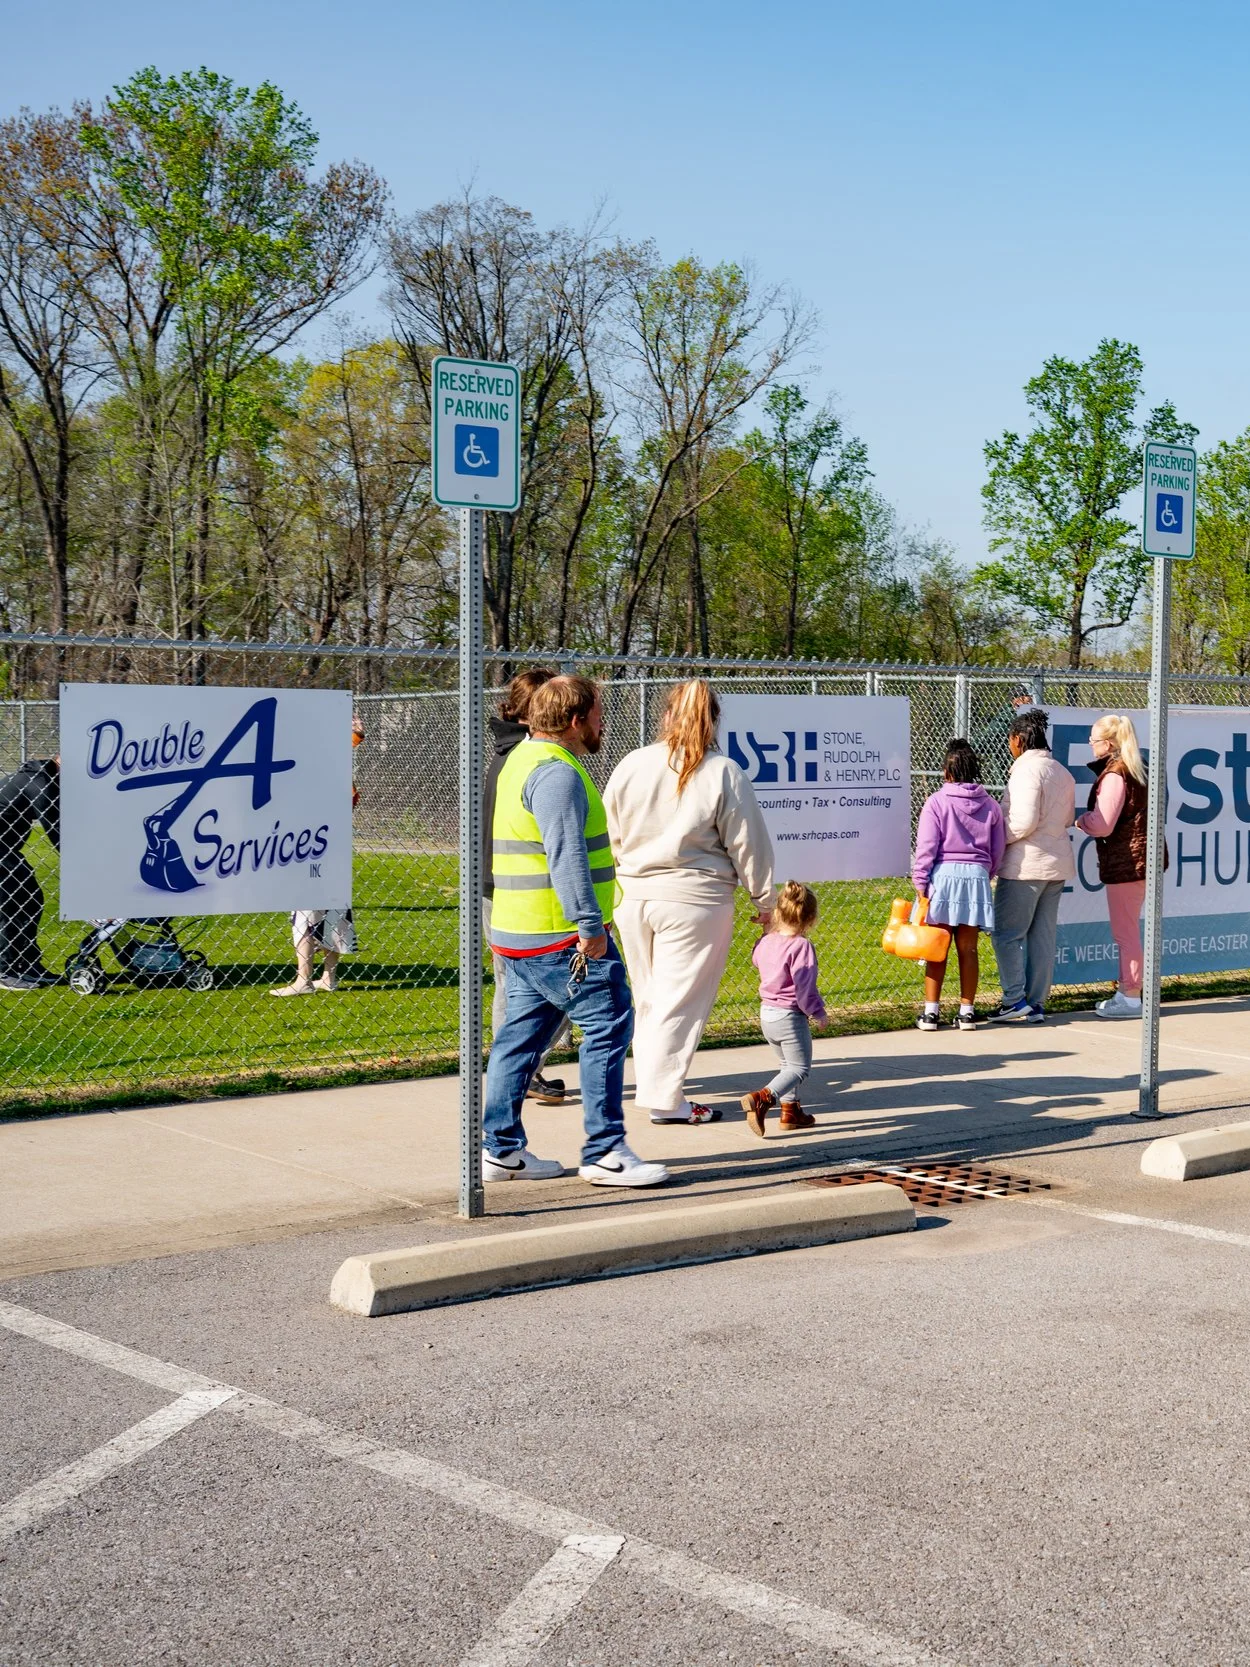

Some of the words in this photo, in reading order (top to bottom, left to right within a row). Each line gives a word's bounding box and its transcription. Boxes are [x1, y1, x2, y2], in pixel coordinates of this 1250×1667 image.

[439, 371, 514, 397] RESERVED
[444, 397, 509, 422] PARKING
[1148, 452, 1193, 473] RESERVED
[1151, 472, 1190, 491] PARKING
[87, 718, 206, 779] Double
[823, 731, 865, 746] STONE,
[116, 696, 296, 836] A
[823, 750, 881, 763] RUDOLPH
[823, 770, 832, 782] &
[878, 768, 901, 781] PLC
[811, 796, 830, 808] Tax
[839, 795, 892, 809] Consulting
[192, 808, 330, 879] Services
[776, 830, 860, 842] www.srhcpas.com
[308, 863, 322, 879] INC
[1074, 942, 1119, 963] WEEKE
[1161, 937, 1197, 956] FORE
[1200, 933, 1249, 954] EASTER
